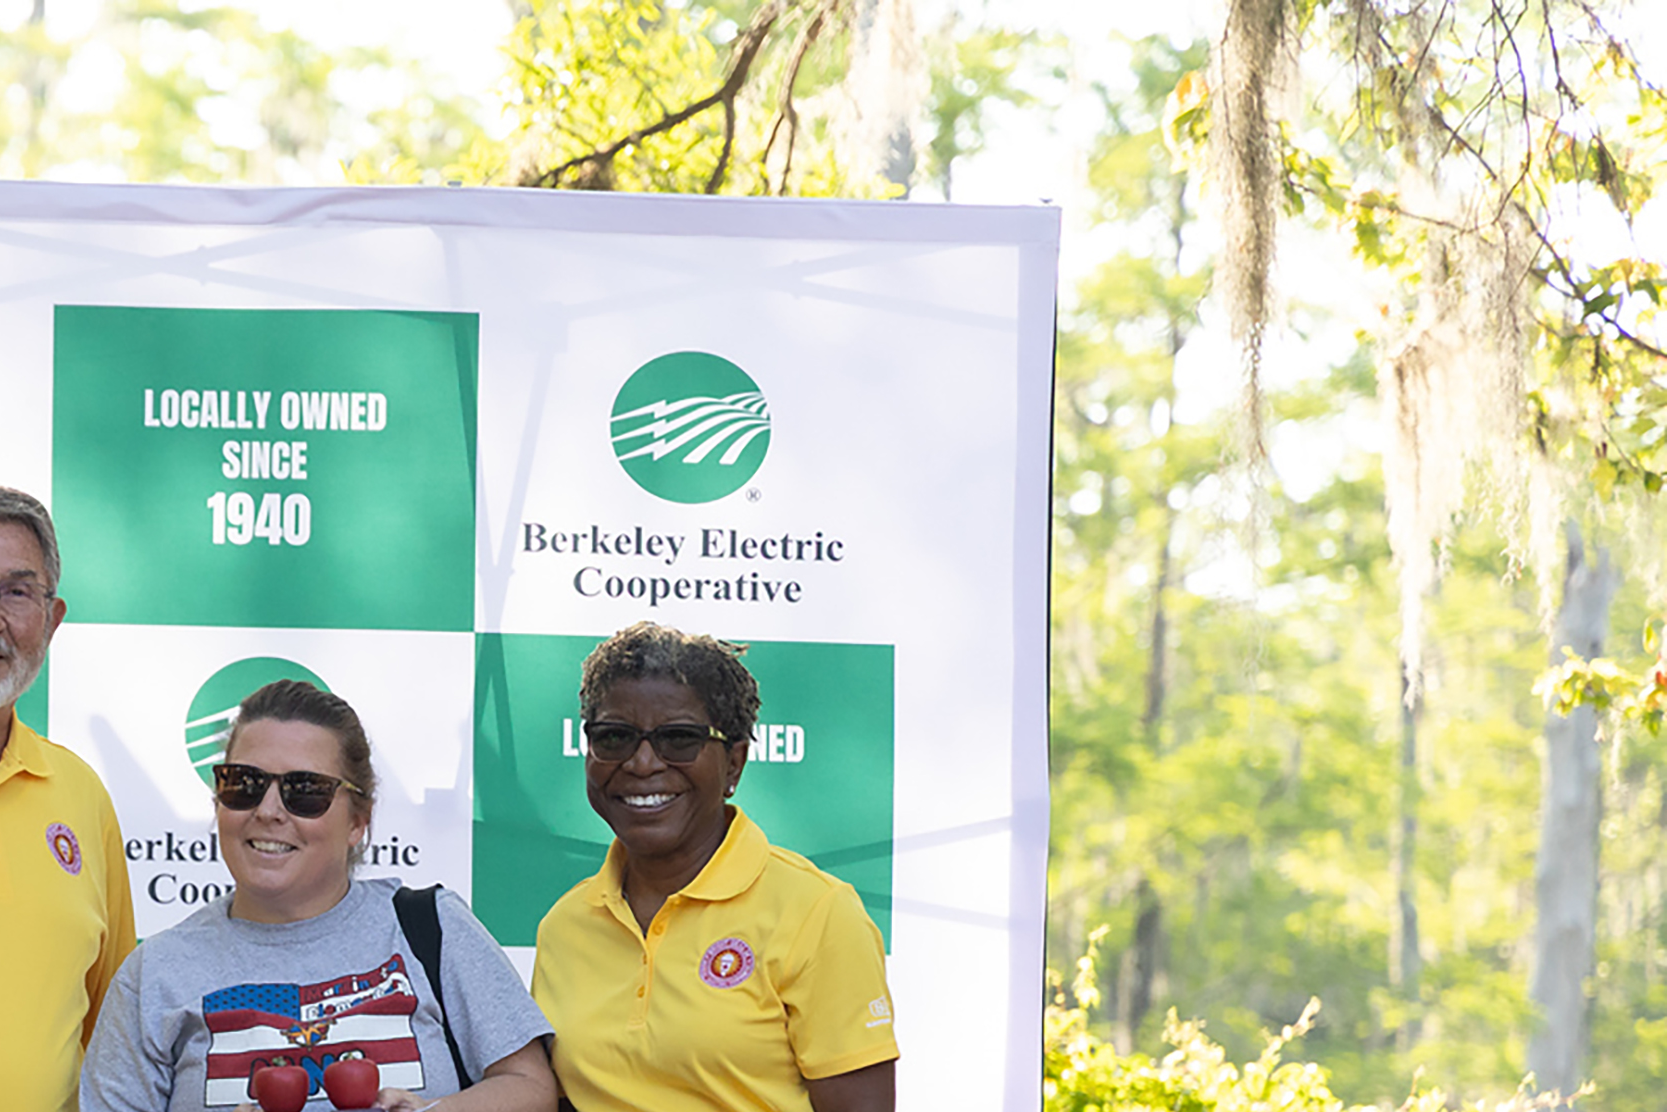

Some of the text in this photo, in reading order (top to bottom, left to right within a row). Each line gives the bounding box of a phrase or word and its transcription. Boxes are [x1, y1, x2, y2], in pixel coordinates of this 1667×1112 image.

[143, 388, 388, 432] LOCALLY OWNED
[221, 439, 308, 481] SINCE
[207, 491, 312, 547] 1940
[522, 522, 845, 565] Berkeley Electric
[572, 566, 803, 607] Cooperative
